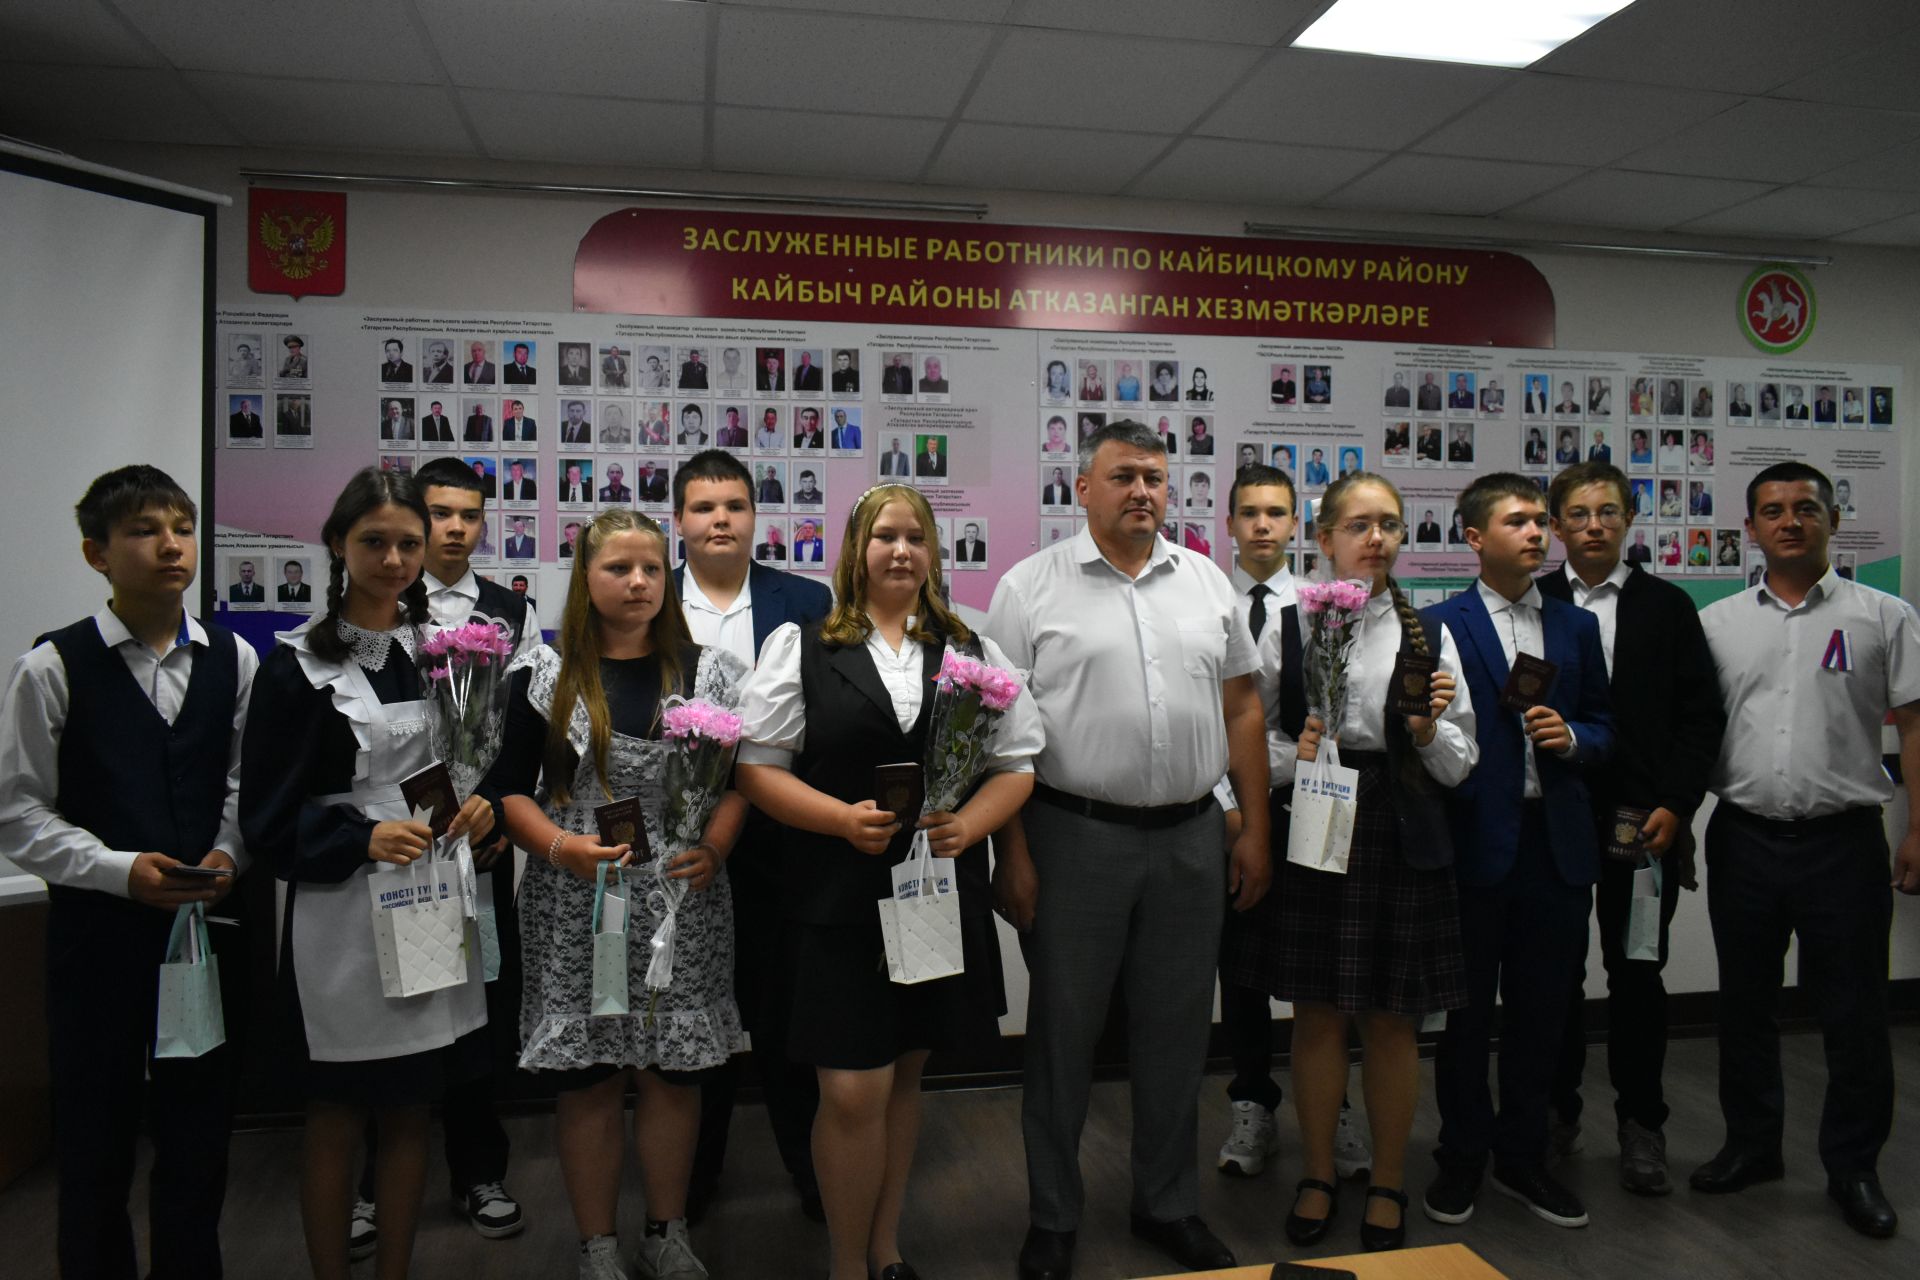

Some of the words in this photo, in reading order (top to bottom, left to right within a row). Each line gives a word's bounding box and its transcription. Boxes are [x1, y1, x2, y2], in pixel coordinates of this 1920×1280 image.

[683, 227, 917, 260] ЗАСЛУЖЕННЫЕ
[926, 239, 1104, 269] РАБОТНИКИ
[1113, 247, 1152, 270] ПО
[1159, 247, 1357, 282] КАЙБИЦКОМУ
[1363, 256, 1469, 286] РАЙОНУ
[732, 273, 862, 305] КАЙБЫЧ
[871, 278, 1000, 310] РАЙОНЫ
[1008, 288, 1189, 319] АТКАЗАНГАН
[1197, 297, 1429, 328] ХЕЗМӘТКӘРЛӘРЕ
[380, 883, 448, 903] КОНСТТУЯ
